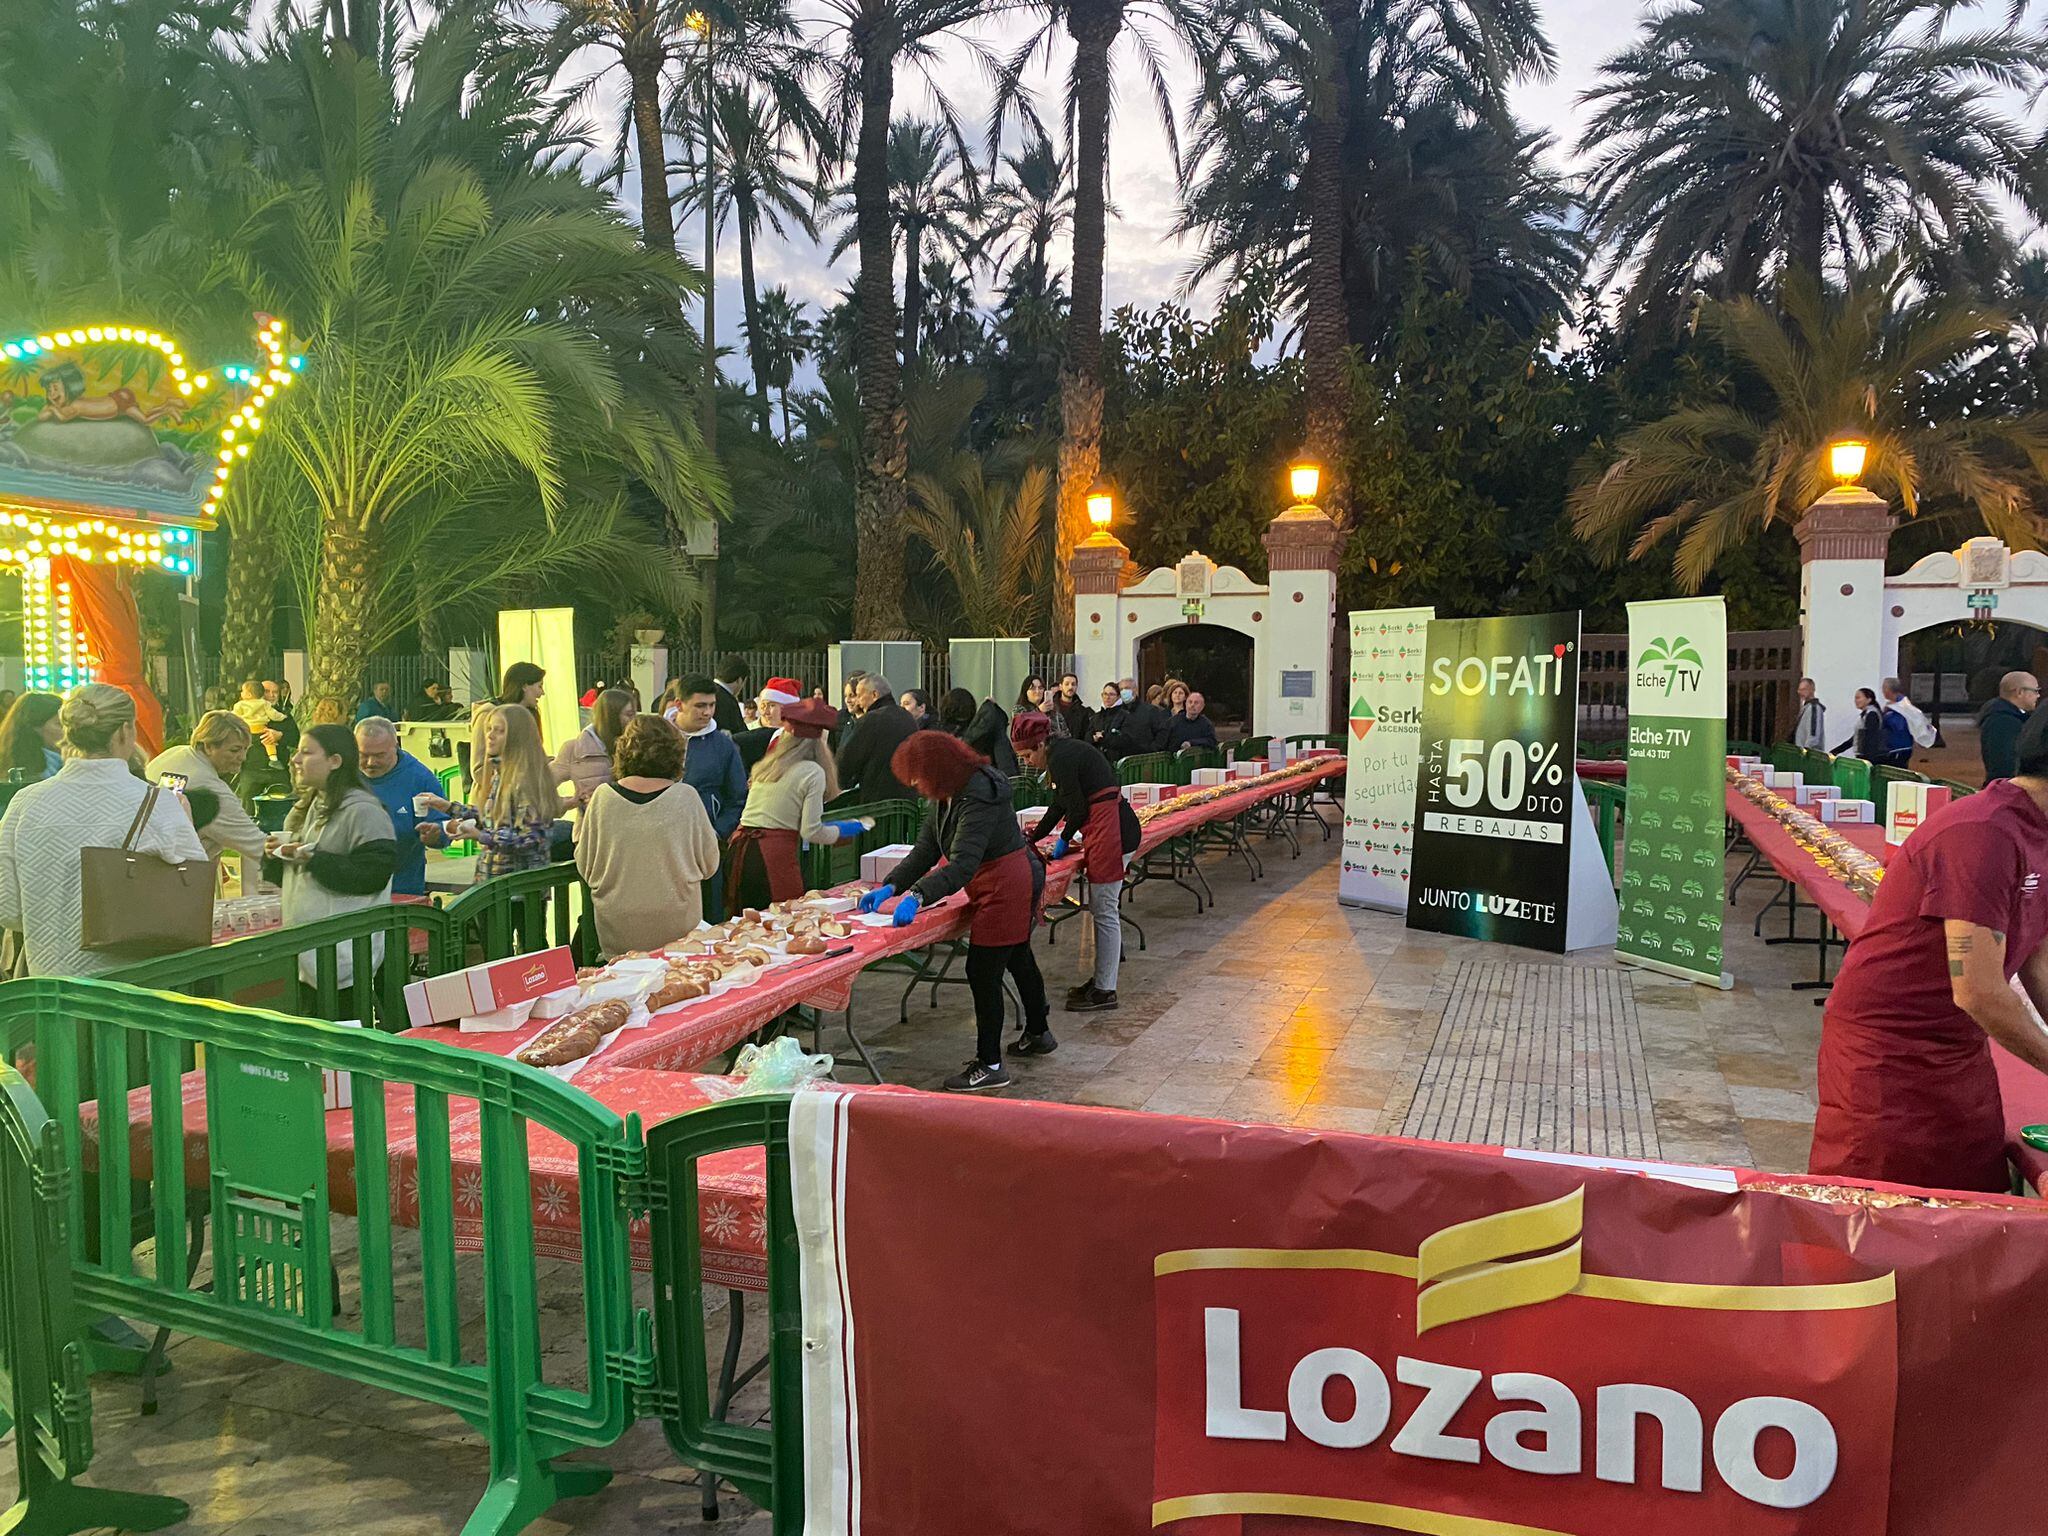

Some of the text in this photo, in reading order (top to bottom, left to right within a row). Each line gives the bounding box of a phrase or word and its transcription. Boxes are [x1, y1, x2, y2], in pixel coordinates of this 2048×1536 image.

[1430, 645, 1564, 696] SOFATI
[1378, 705, 1423, 724] Serk
[1377, 725, 1421, 734] ASCENSOR
[1630, 726, 1691, 747] Elche 7TV
[1364, 751, 1408, 773] Por tu
[1629, 747, 1671, 759] Canal 43 TDT
[1427, 739, 1444, 803] HASTA
[1527, 795, 1563, 814] DTO
[1440, 816, 1549, 840] REBAJAS
[1418, 887, 1471, 911] JUNTO
[524, 971, 546, 985] Lozano
[1204, 1307, 1839, 1510] Lozano
